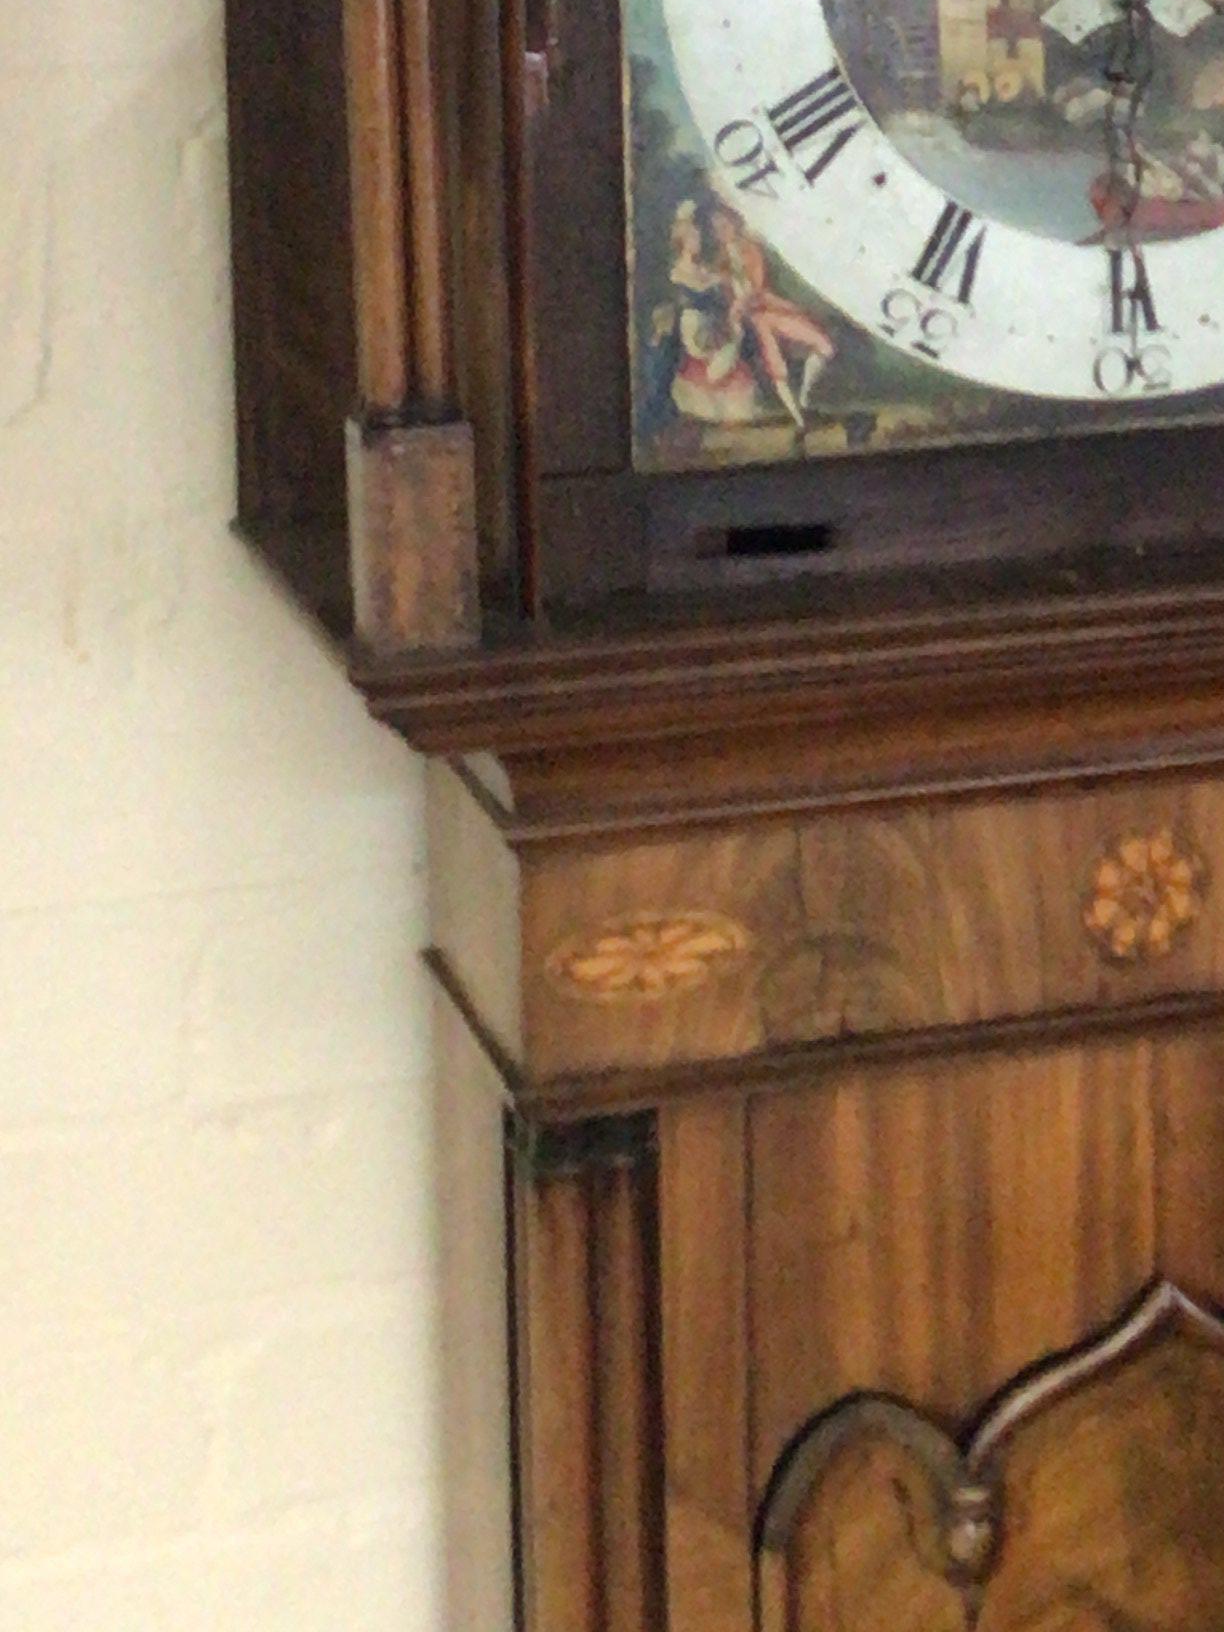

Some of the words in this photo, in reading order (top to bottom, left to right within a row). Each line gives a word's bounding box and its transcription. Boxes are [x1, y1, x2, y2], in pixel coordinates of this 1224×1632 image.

[713, 118, 781, 202] 40
[767, 66, 867, 190] VIII
[911, 198, 989, 310] VII
[880, 286, 960, 360] 35
